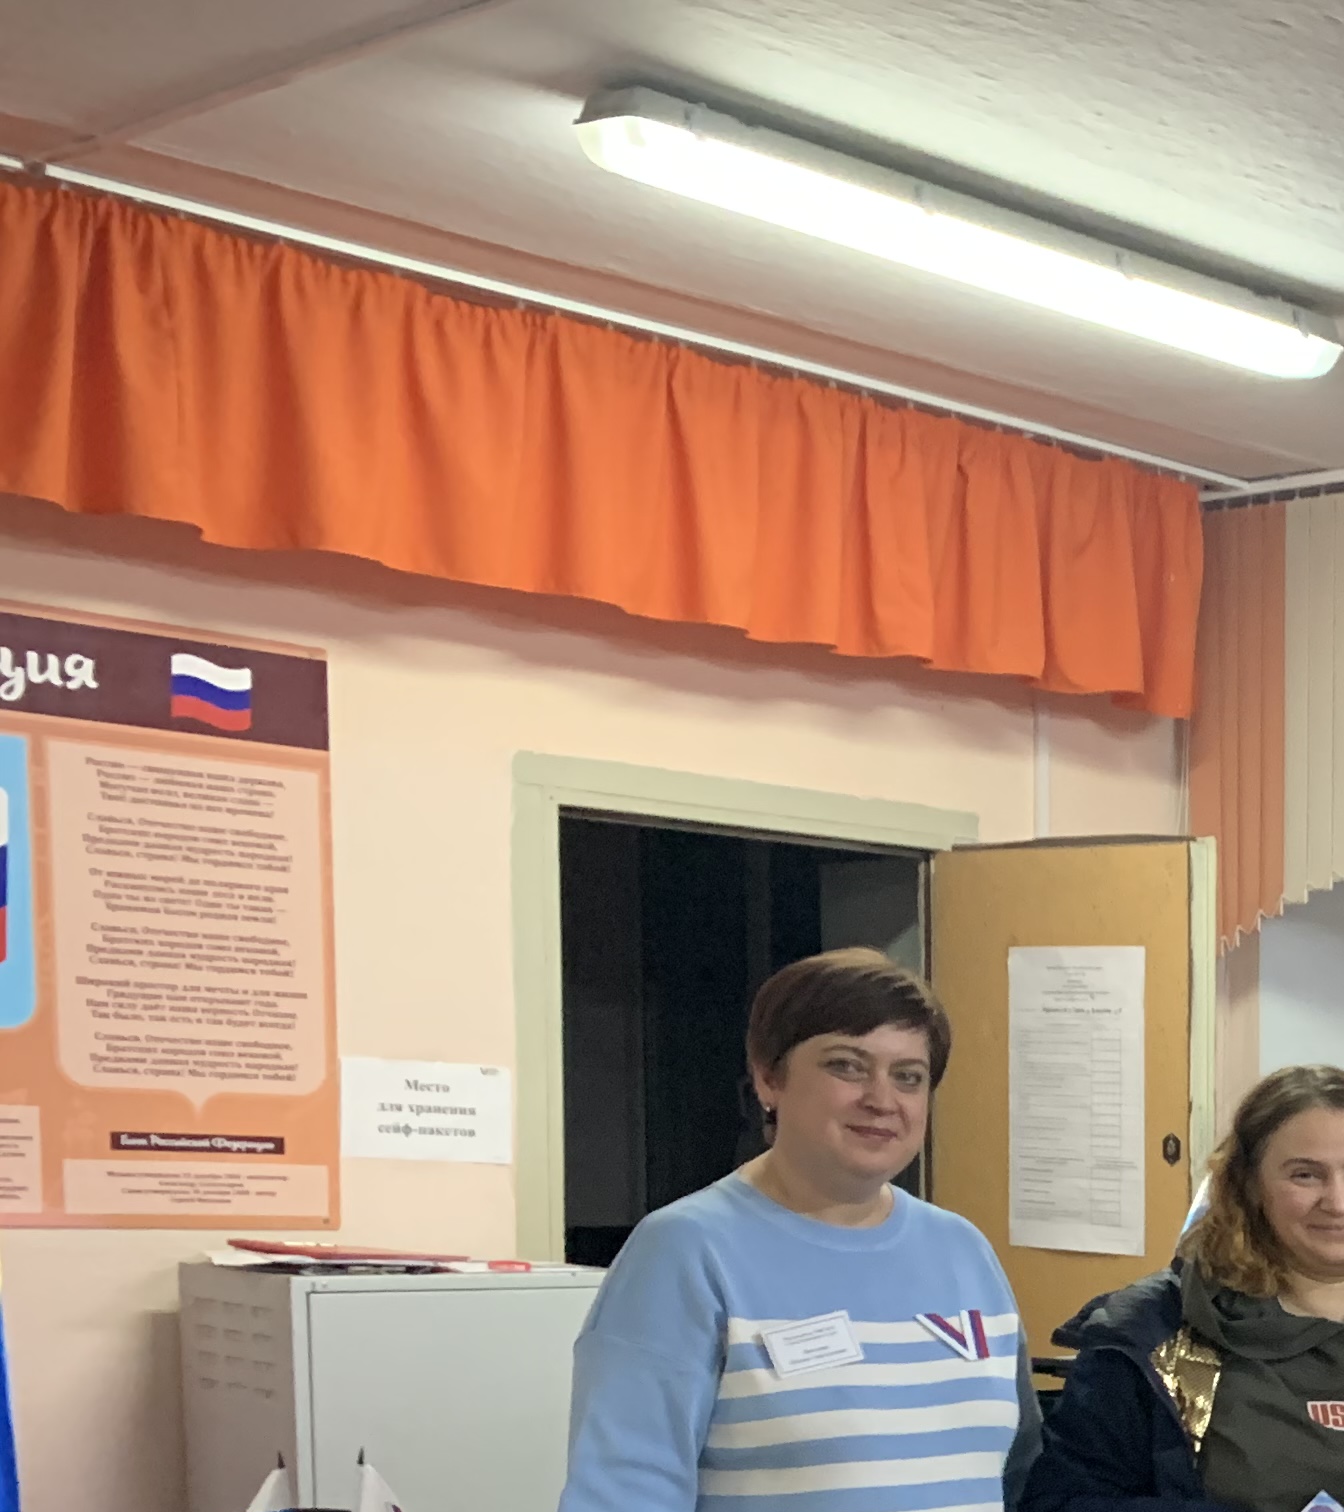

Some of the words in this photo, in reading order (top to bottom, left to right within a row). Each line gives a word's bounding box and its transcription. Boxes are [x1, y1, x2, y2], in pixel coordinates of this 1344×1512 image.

[404, 1078, 451, 1094] Место
[377, 1102, 403, 1112] для
[407, 1103, 477, 1117] хранения
